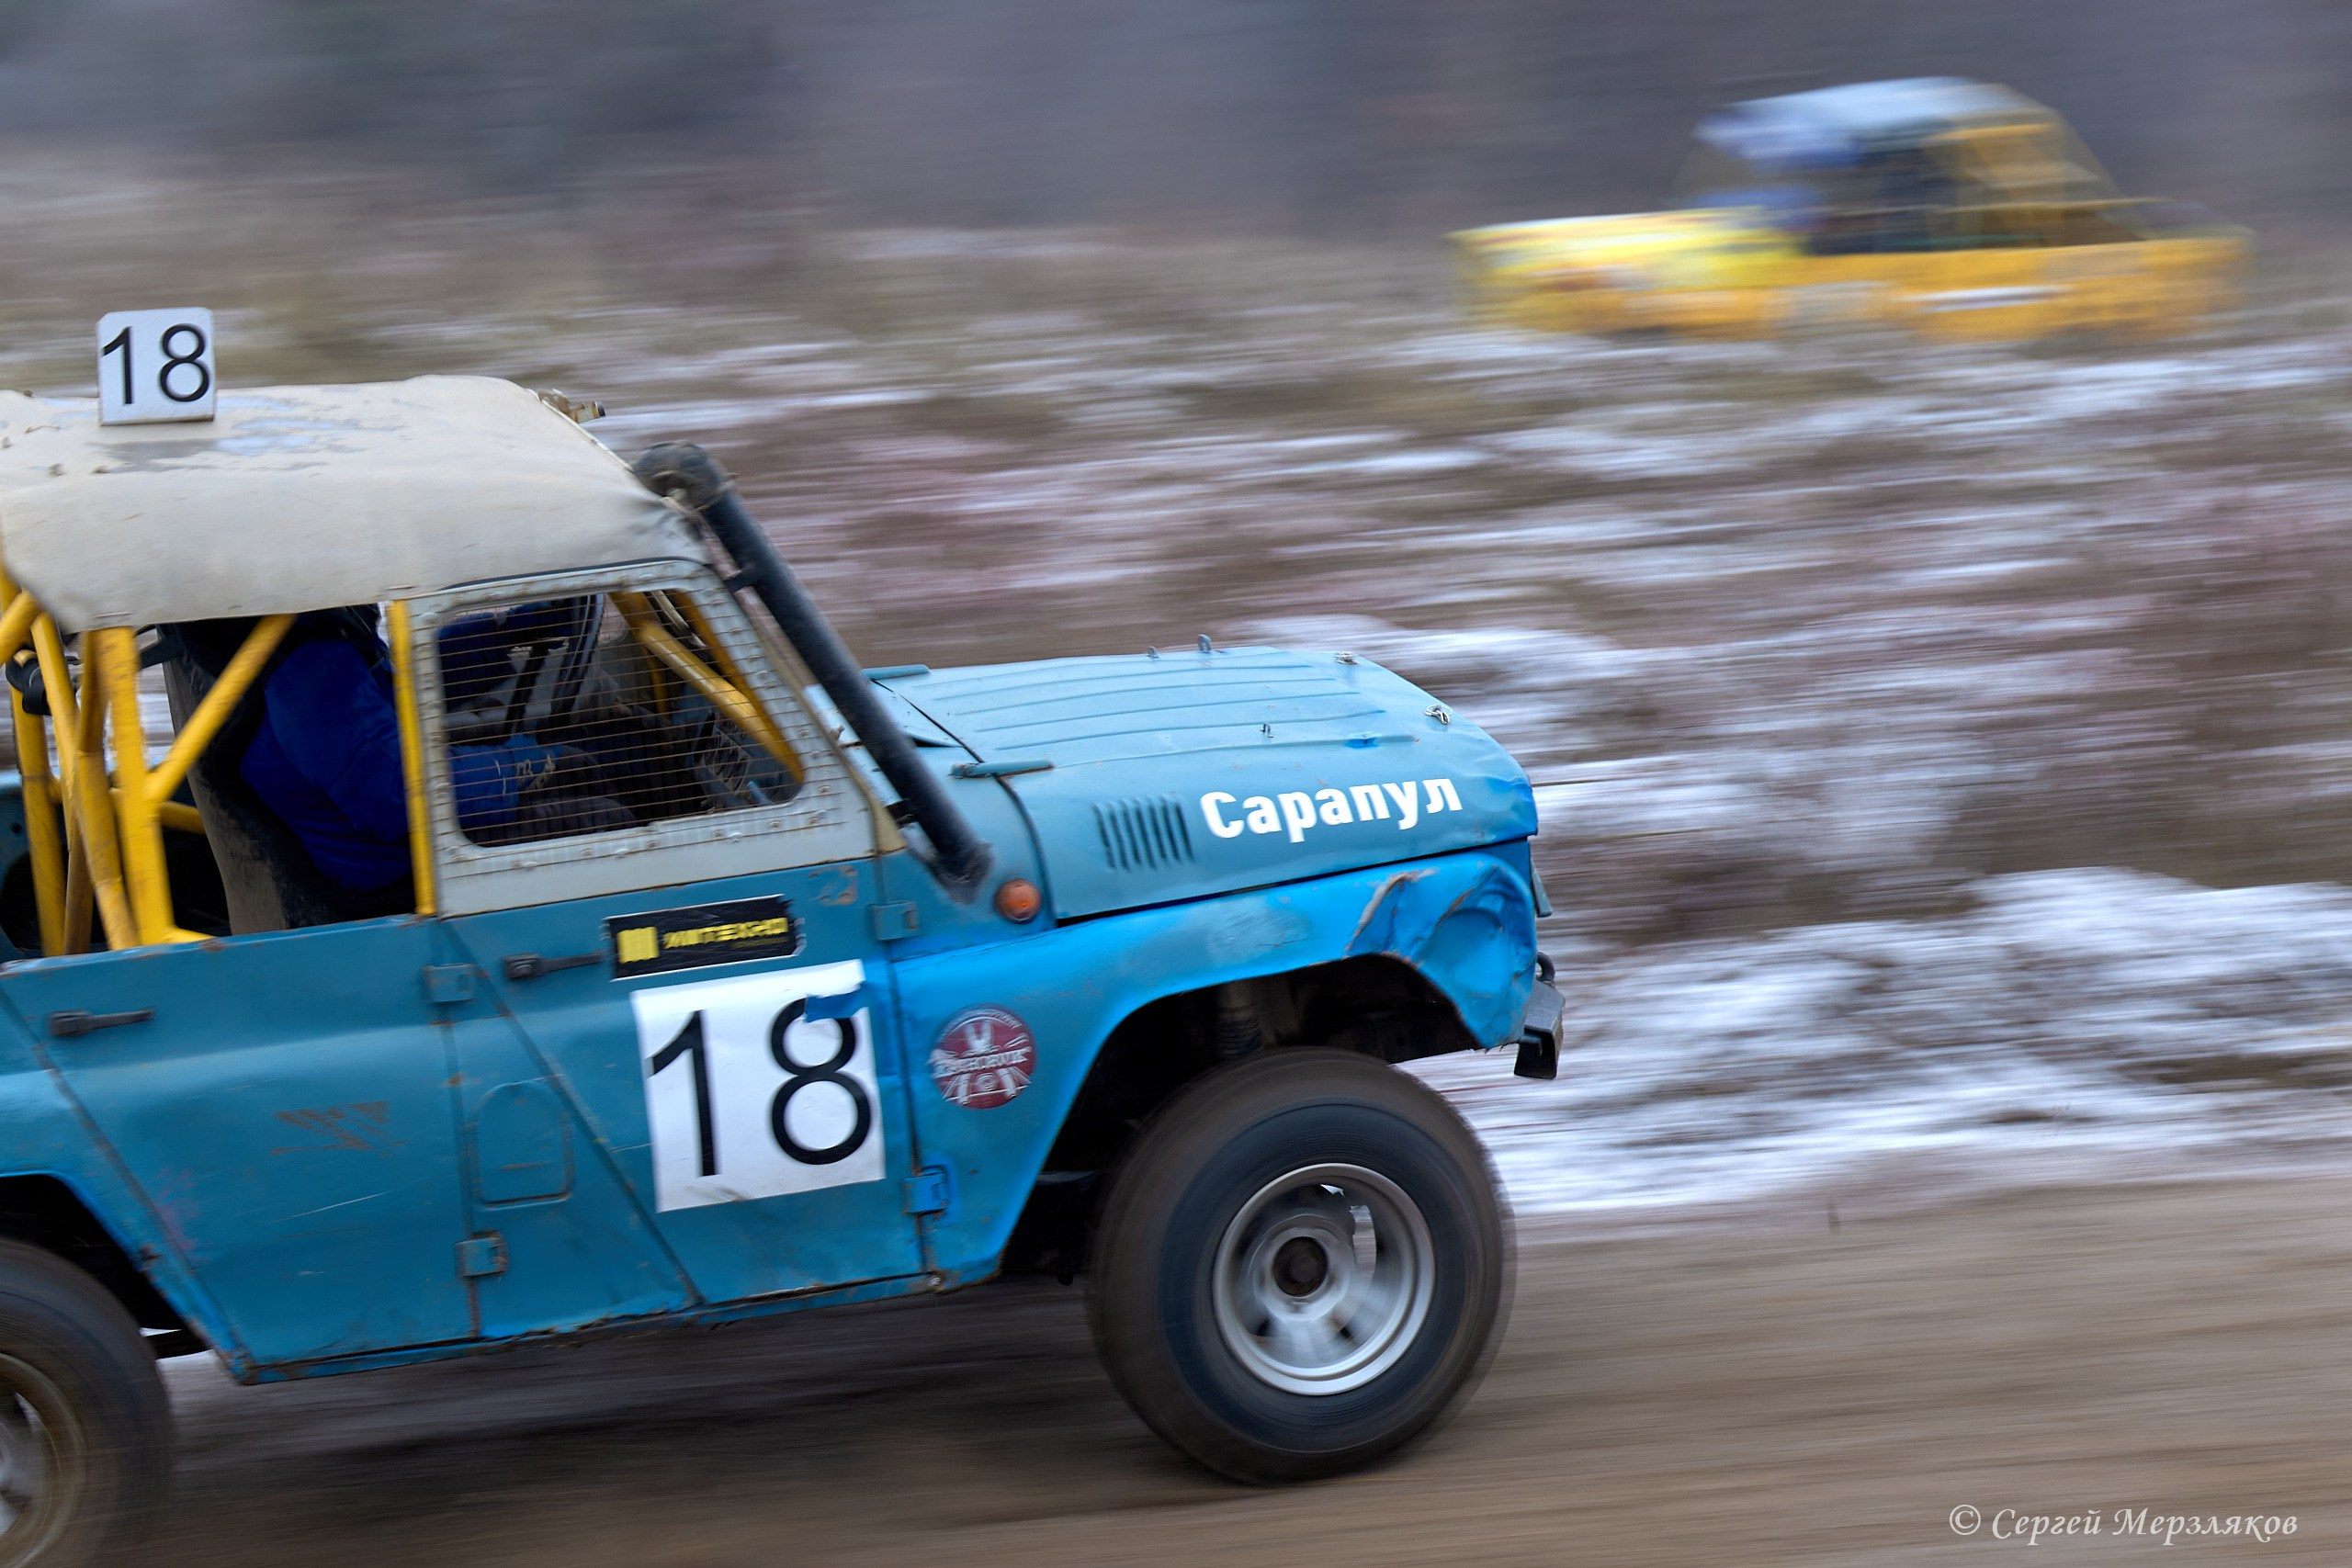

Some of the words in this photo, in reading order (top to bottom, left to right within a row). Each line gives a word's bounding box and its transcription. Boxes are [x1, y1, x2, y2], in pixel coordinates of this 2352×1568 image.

[101, 323, 210, 405] 18
[1200, 778, 1463, 843] Сарапул
[646, 997, 873, 1177] 18
